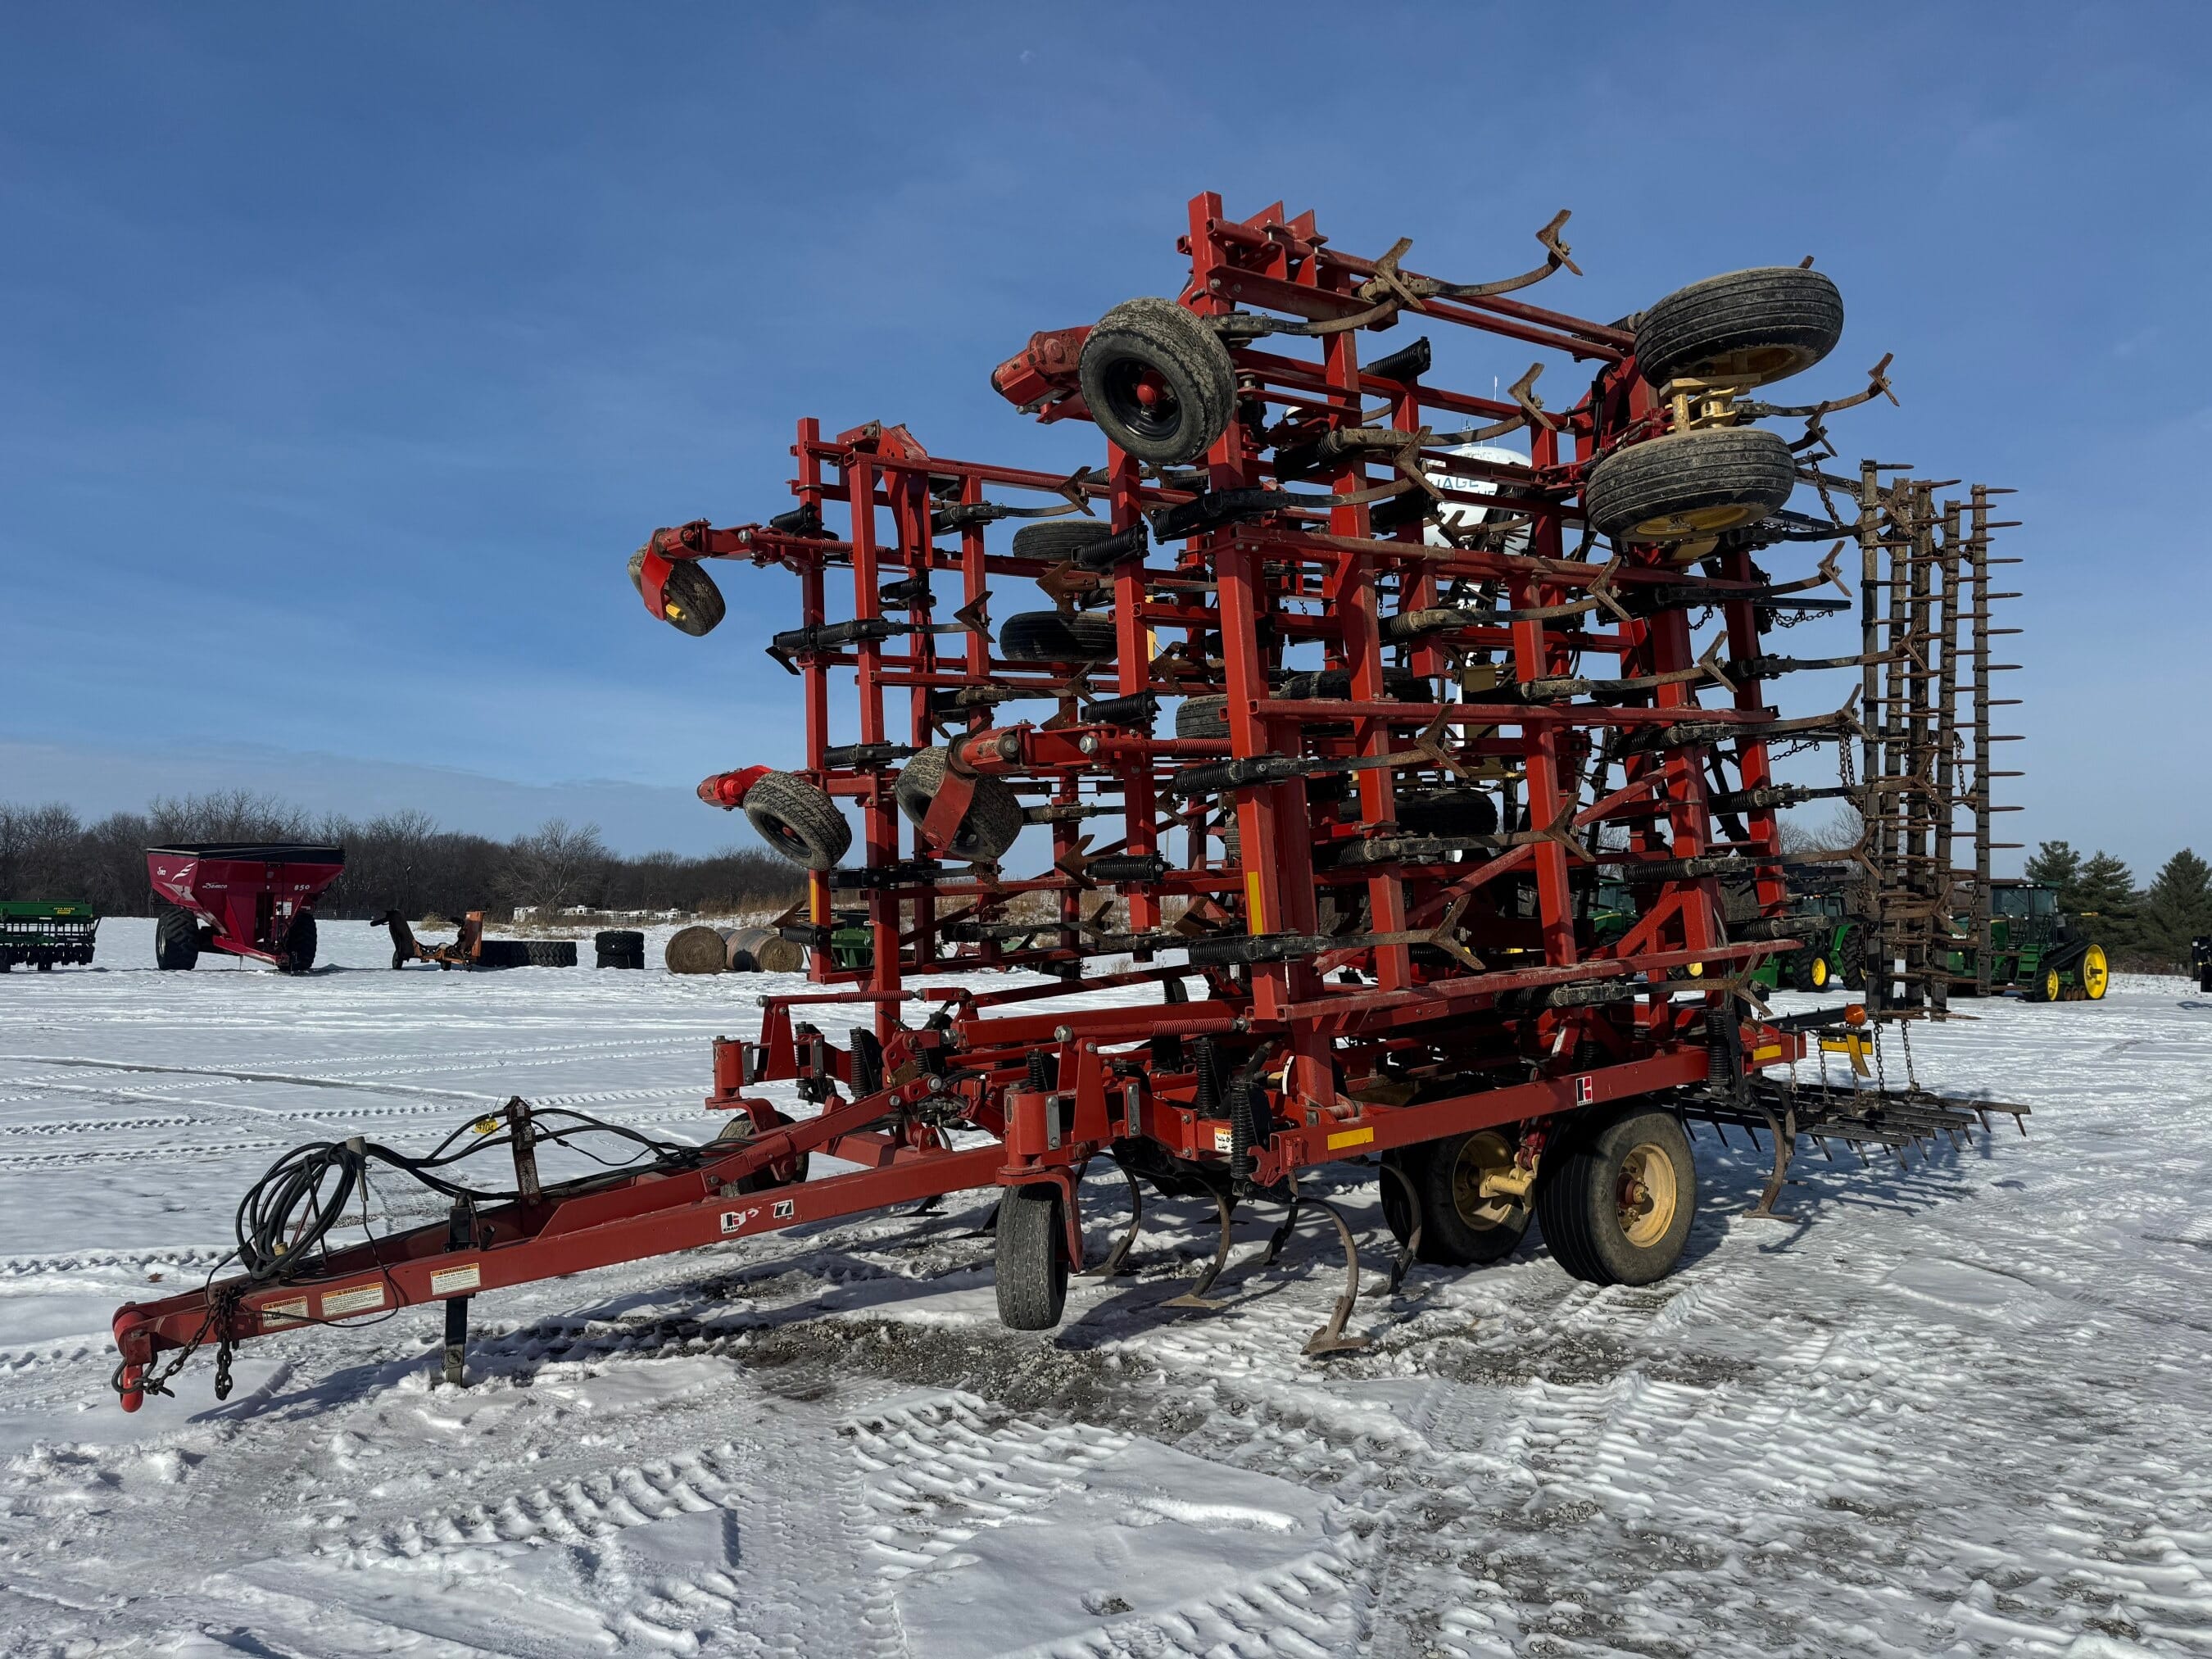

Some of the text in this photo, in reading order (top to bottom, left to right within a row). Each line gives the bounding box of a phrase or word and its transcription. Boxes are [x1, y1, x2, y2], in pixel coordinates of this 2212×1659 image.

[443, 1265, 471, 1275] WARNING
[342, 1286, 368, 1294] WARNING
[273, 1299, 301, 1308] WARNING
